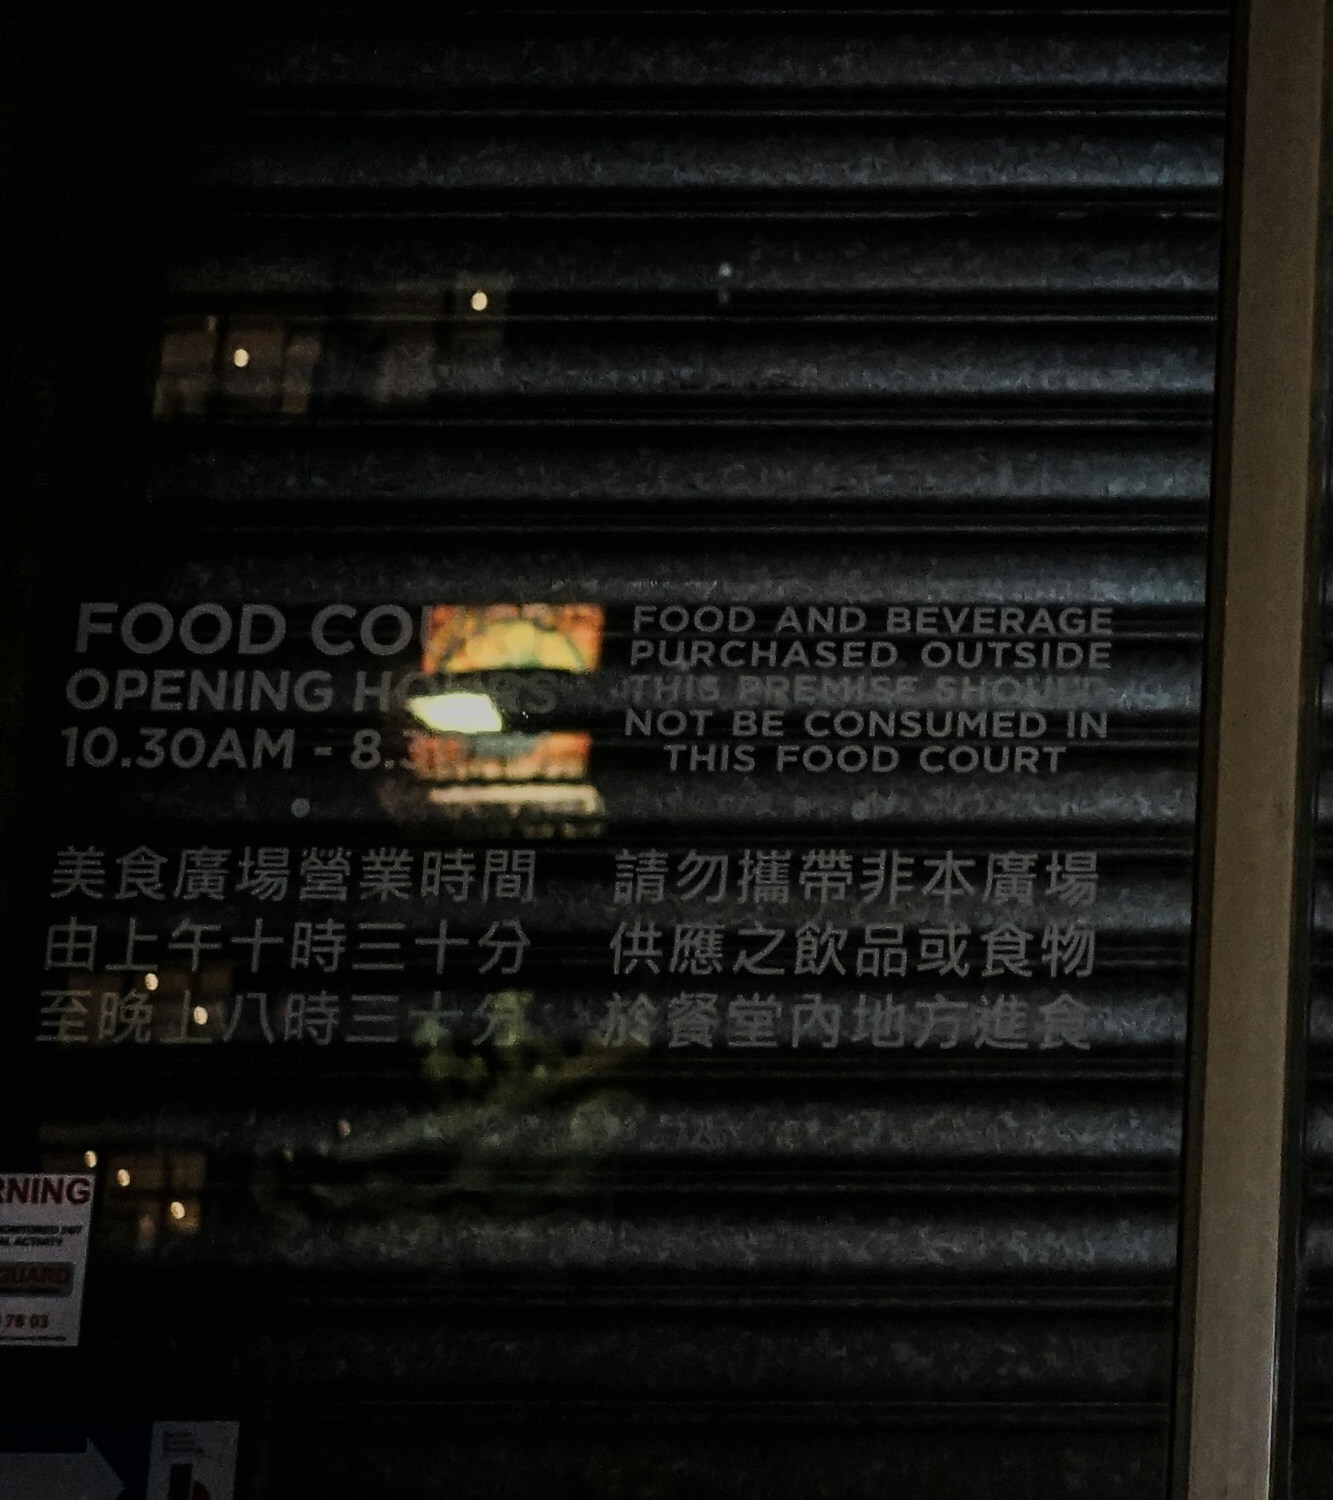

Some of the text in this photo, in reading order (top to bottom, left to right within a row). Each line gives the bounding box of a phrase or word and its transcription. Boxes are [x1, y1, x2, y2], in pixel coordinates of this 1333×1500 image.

[73, 601, 288, 655] FOOD
[632, 604, 1114, 638] FOOD AND BEVERAGE
[630, 641, 1112, 670] PURCHASED OUTSIDE
[65, 668, 334, 712] OPENING
[629, 674, 719, 701] THIS
[738, 674, 919, 702] PREMISE
[623, 710, 1109, 739] NOT BE CONSUMED IN
[60, 727, 296, 770] 10.30AM
[663, 744, 1068, 774] THIS FOOD COURT
[49, 843, 538, 903] 美食廣場營業時間
[612, 848, 1100, 906] 請勿攜帶非本廣場
[42, 915, 533, 977] 由上午十時三十分
[608, 920, 1098, 979] 供應之飲品或食物
[34, 987, 527, 1047] 至晚上八時三十分
[0, 1177, 91, 1204] NING
